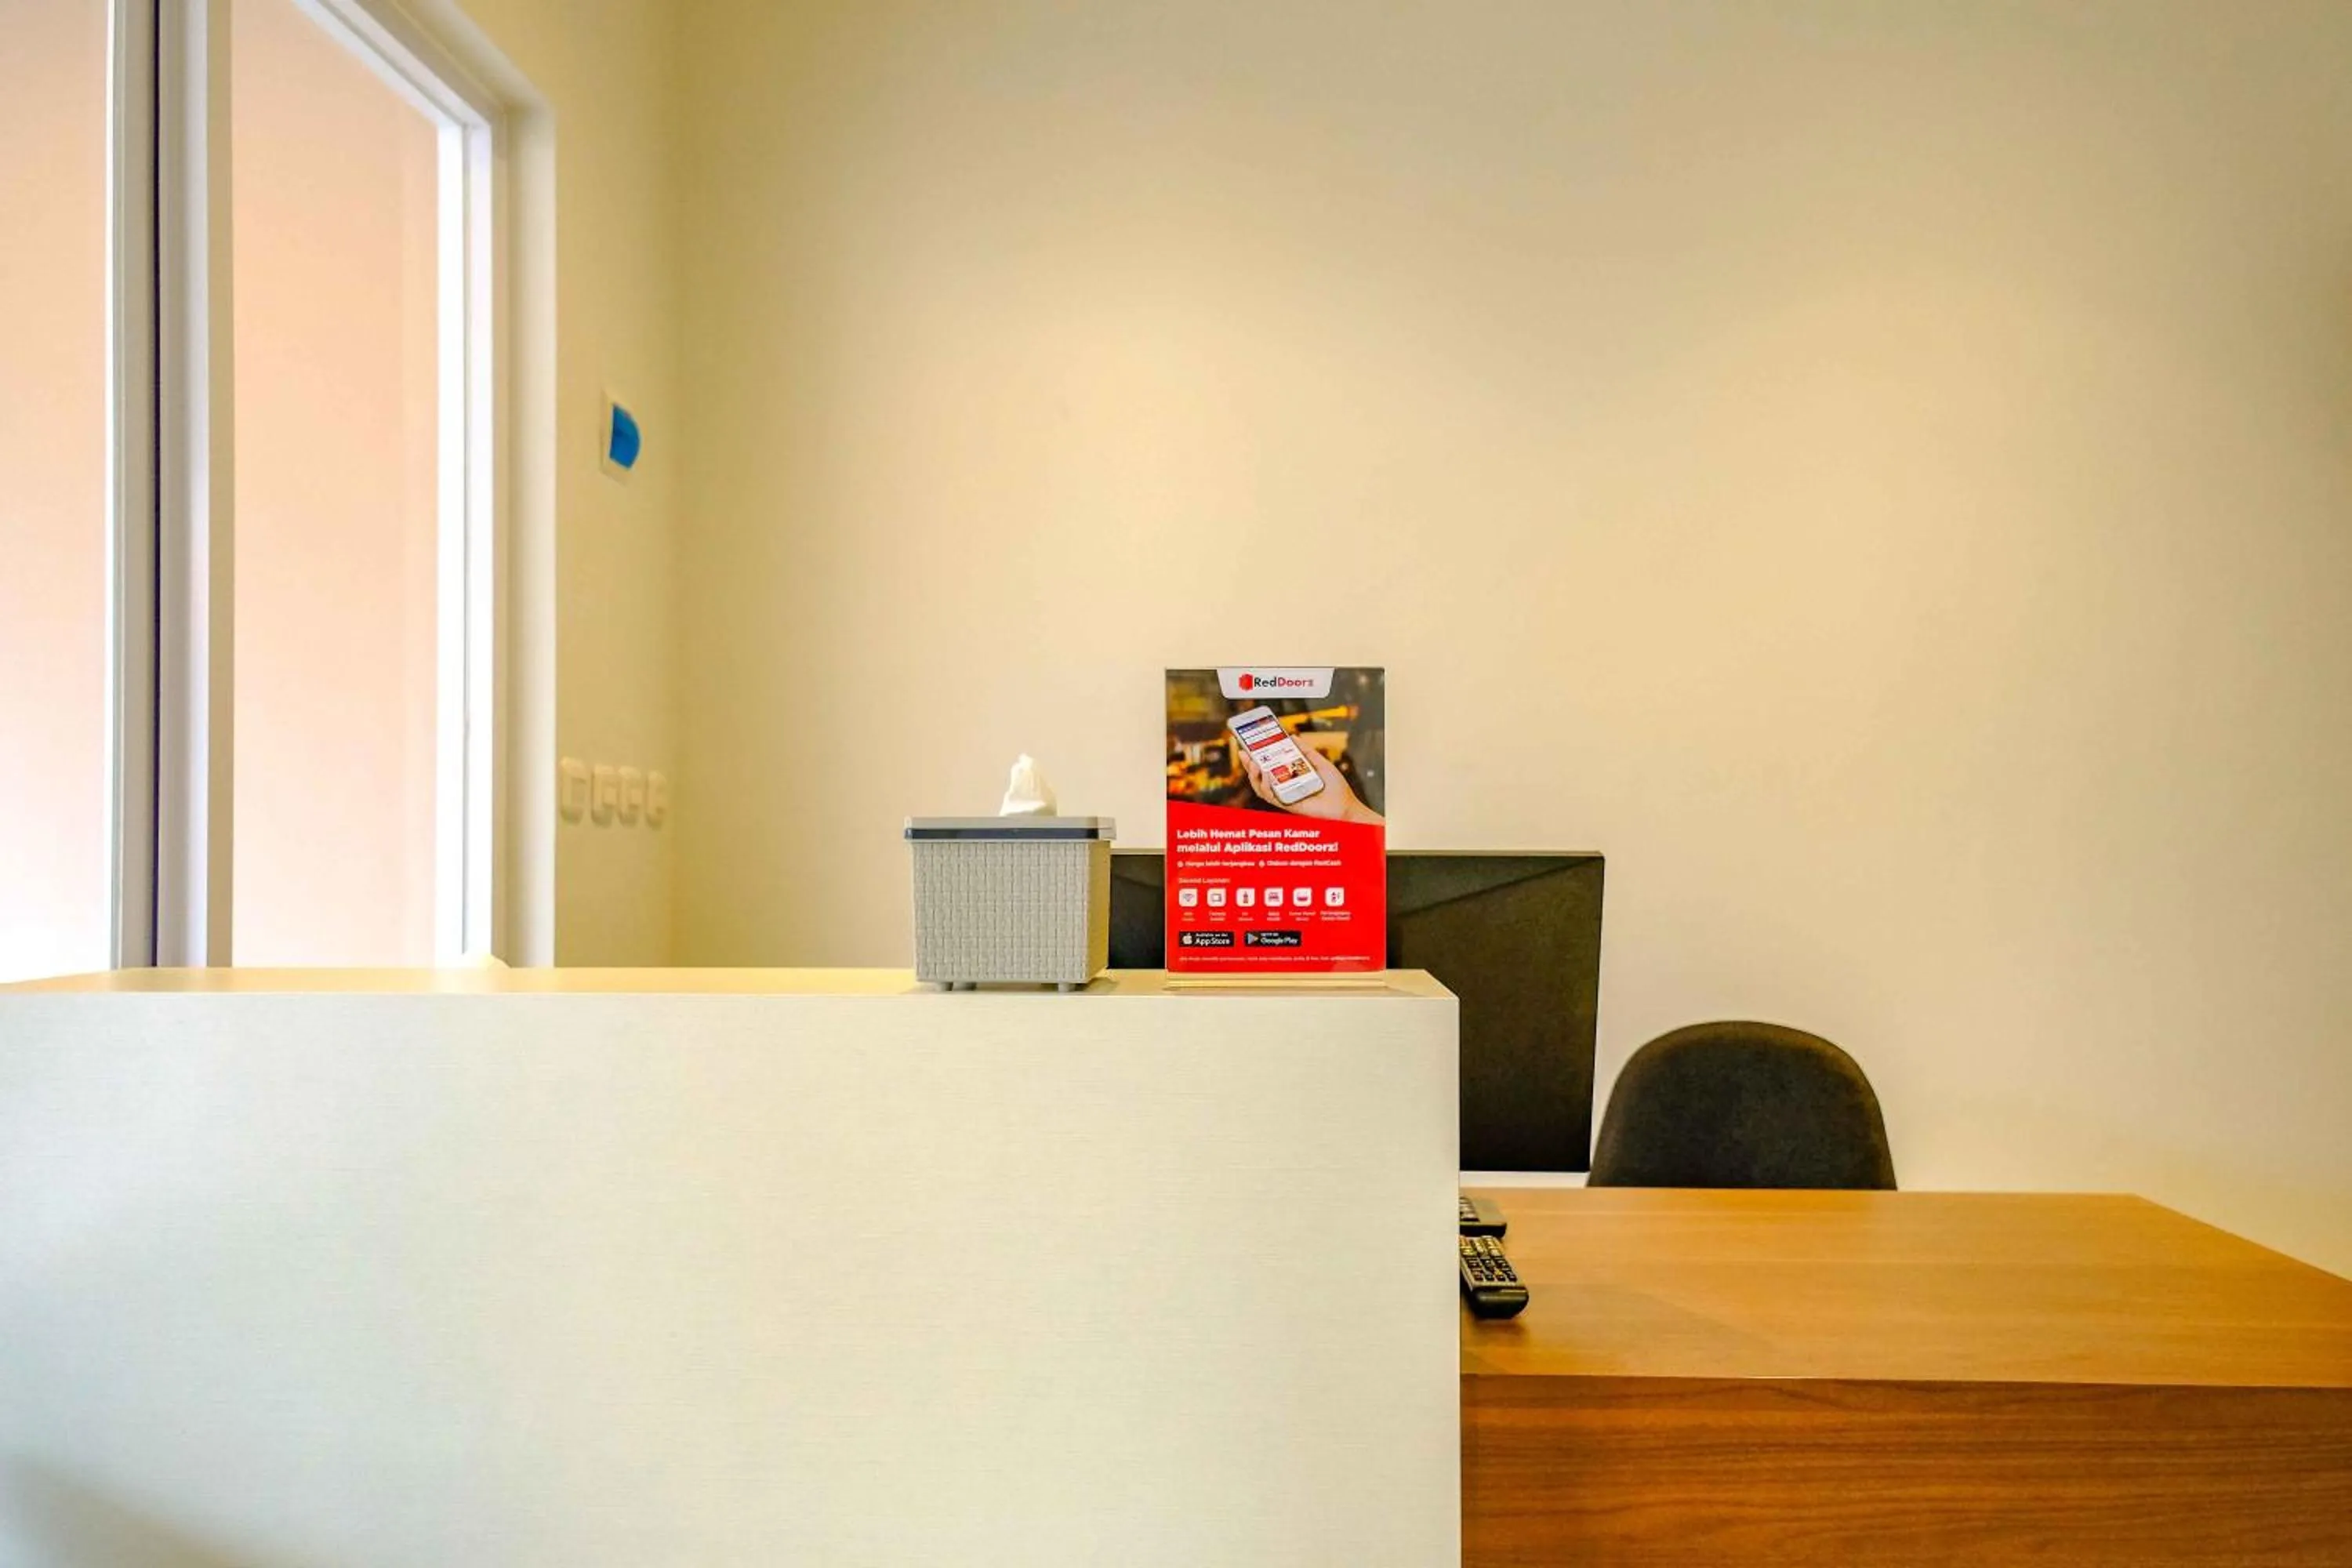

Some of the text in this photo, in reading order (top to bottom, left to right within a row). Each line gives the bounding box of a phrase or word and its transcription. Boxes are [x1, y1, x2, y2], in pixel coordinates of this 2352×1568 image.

[1177, 829, 1319, 839] Lebih Hemat Pesan Kamar
[1177, 842, 1221, 852] melalui
[1224, 842, 1272, 854] Aplikasi
